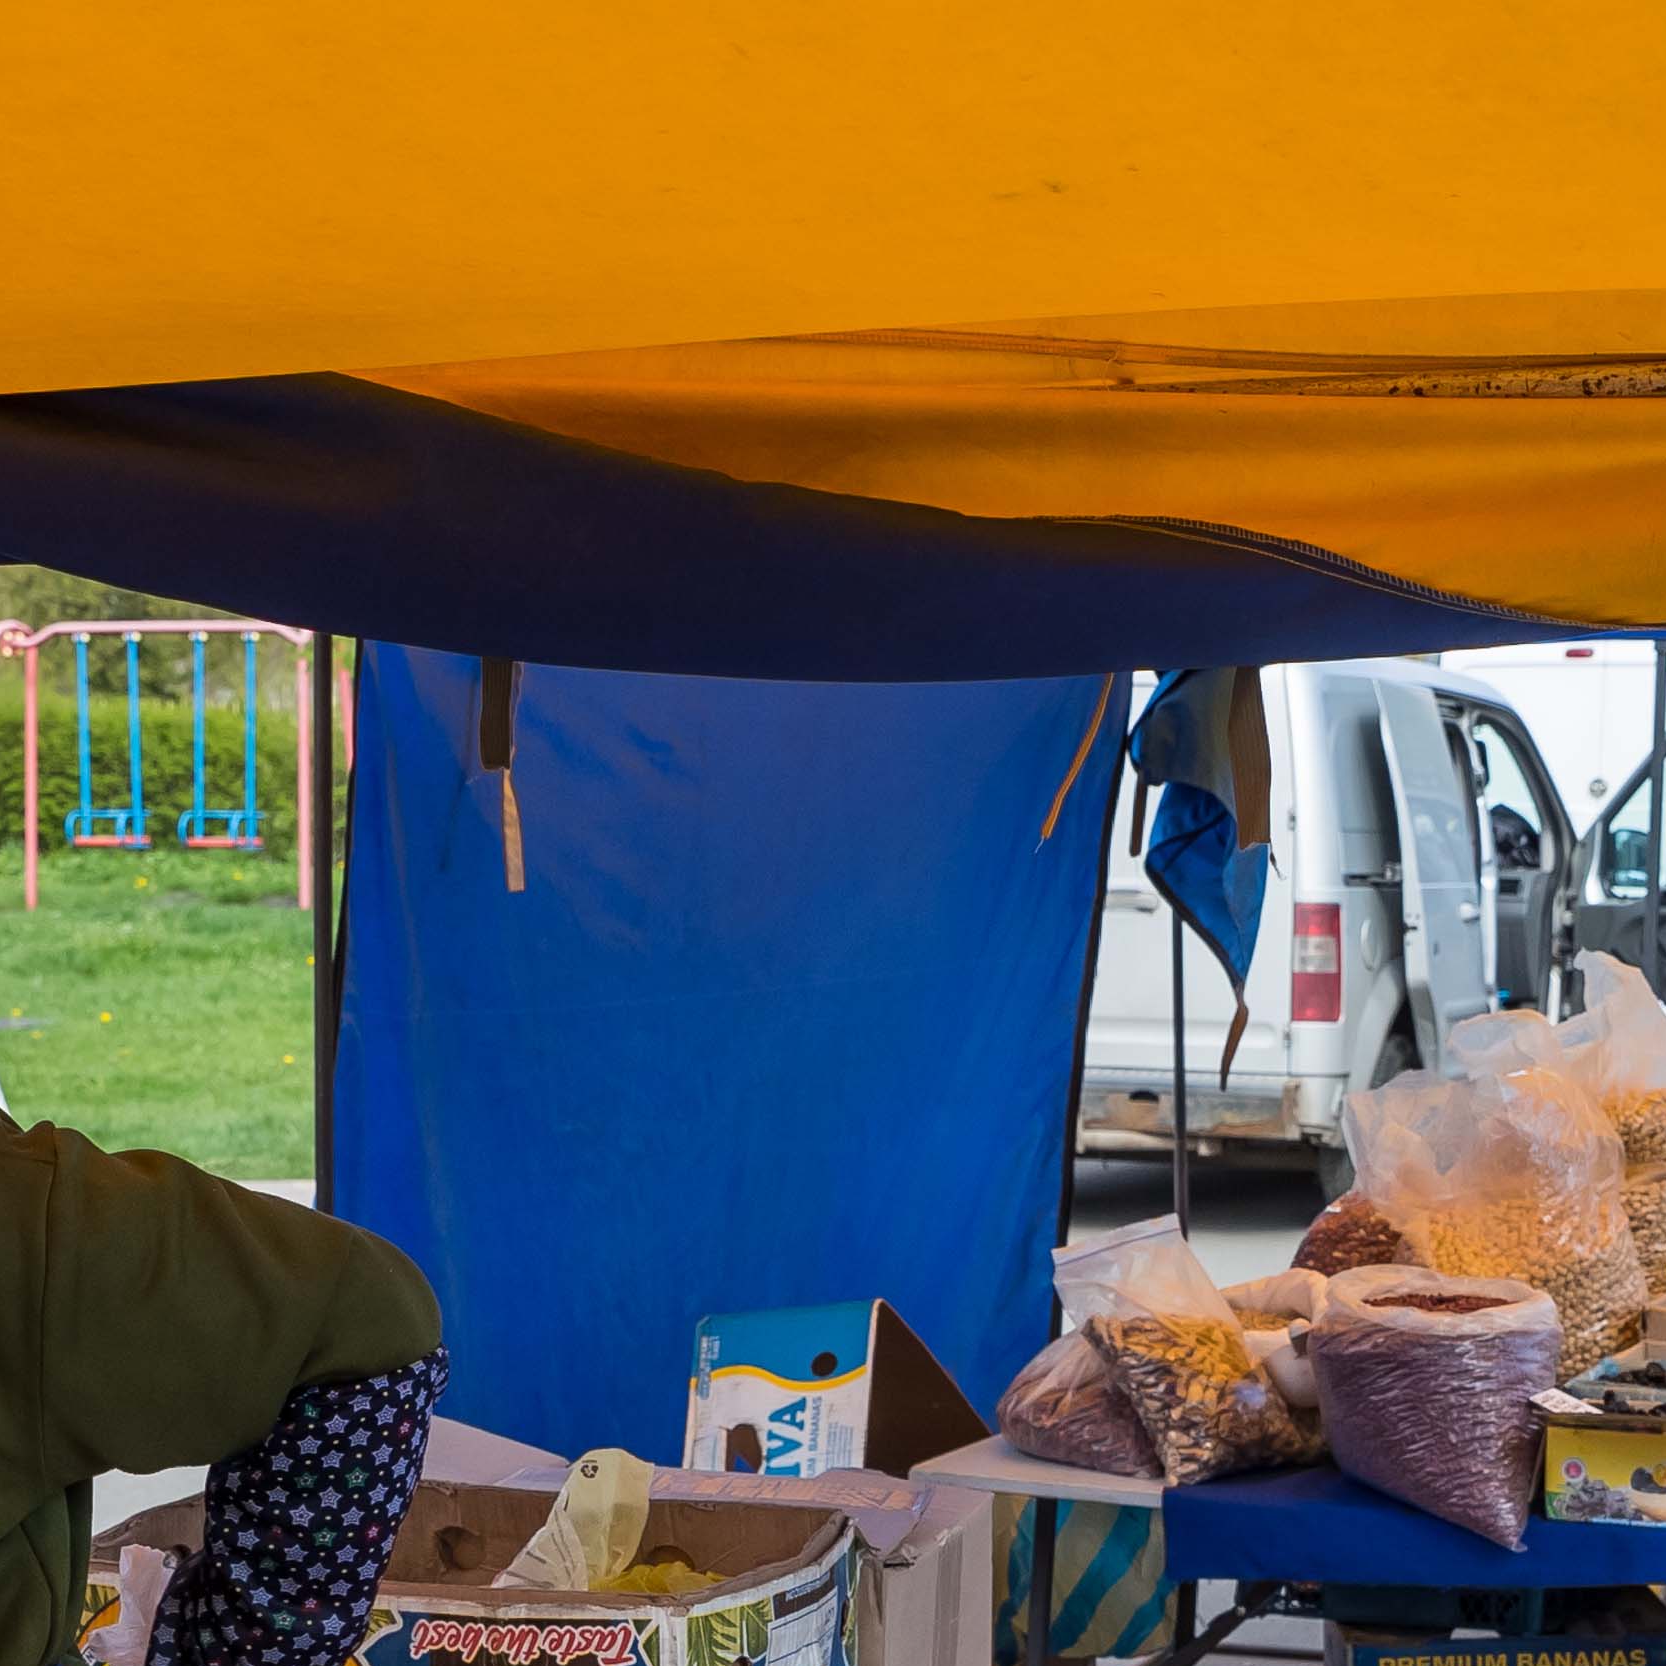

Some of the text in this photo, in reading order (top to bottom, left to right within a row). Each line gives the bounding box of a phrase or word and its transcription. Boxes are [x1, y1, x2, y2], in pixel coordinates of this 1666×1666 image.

[807, 1396, 822, 1452] BANANAS
[410, 1619, 486, 1664] best
[485, 1623, 541, 1665] the
